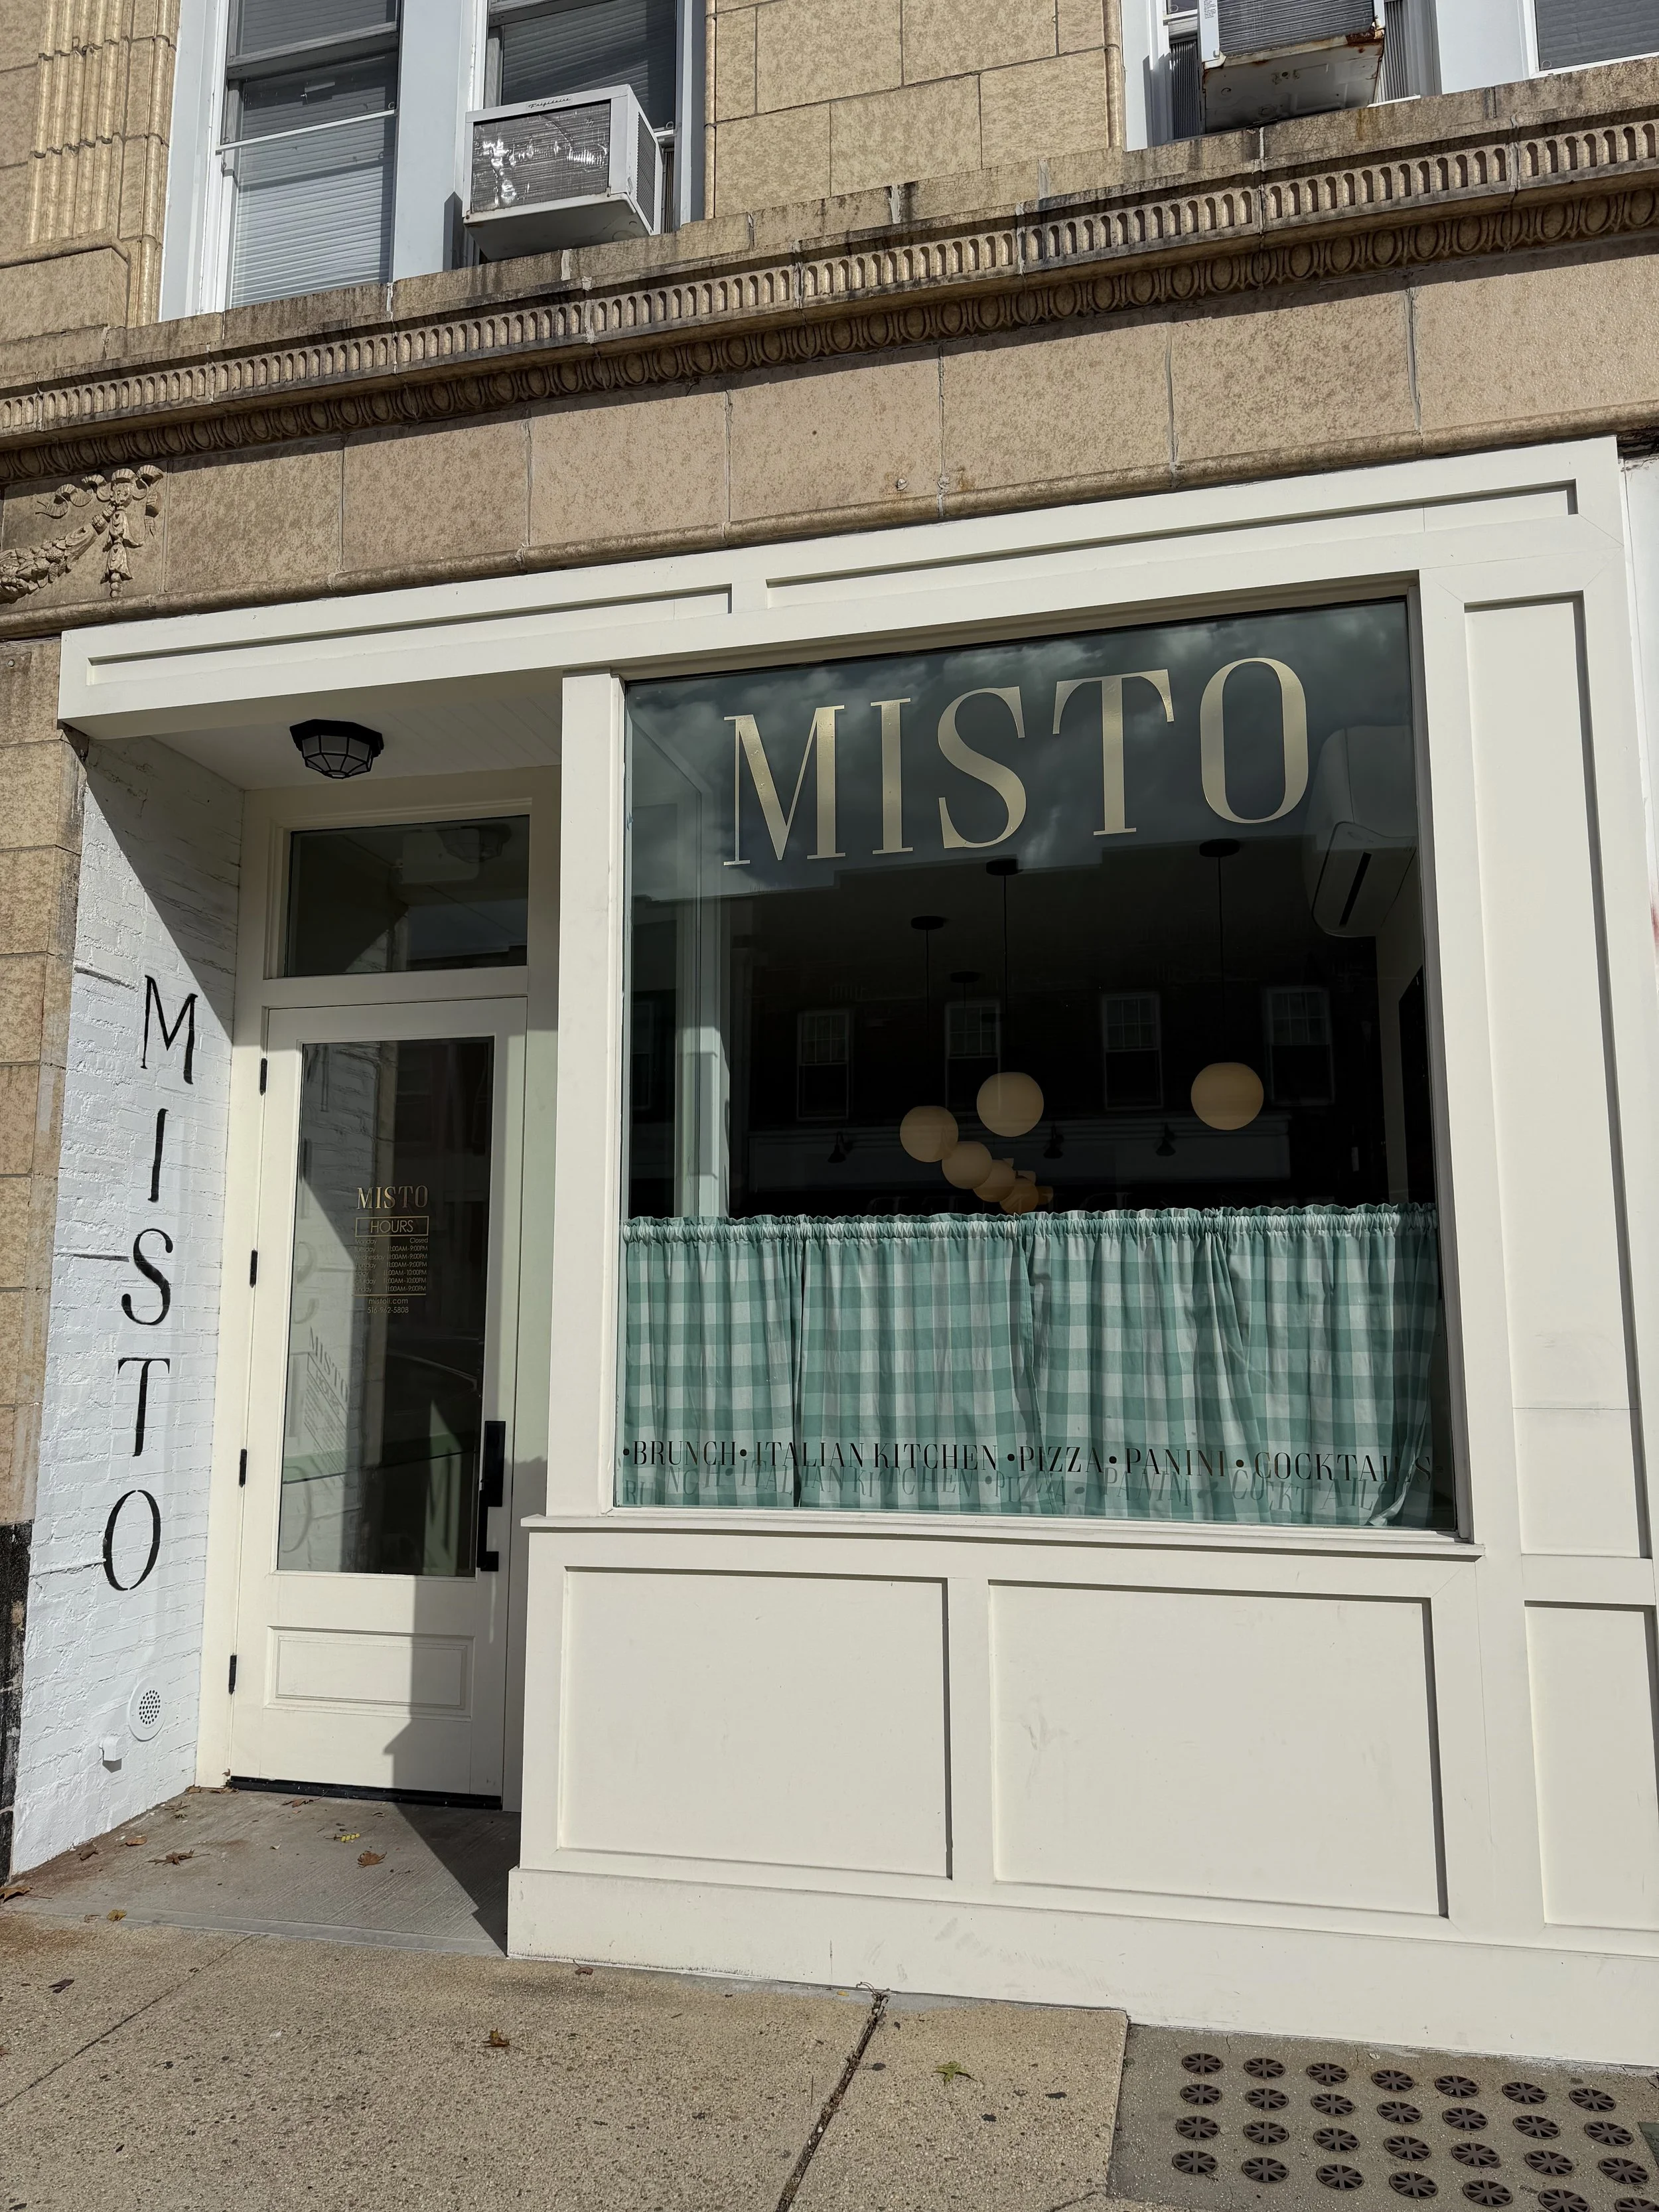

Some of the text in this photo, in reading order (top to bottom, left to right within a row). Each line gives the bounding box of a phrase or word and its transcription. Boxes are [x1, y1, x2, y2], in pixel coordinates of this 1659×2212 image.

[723, 657, 1309, 865] MISTO
[356, 1185, 429, 1209] MISTO
[370, 1220, 413, 1233] HOURS
[102, 974, 198, 1592] MISTO
[632, 1440, 736, 1466] BRUNCH
[757, 1441, 865, 1468] ITALIAN
[874, 1443, 997, 1471] KITCHEN
[1019, 1445, 1104, 1473] PIZZA
[1125, 1447, 1226, 1477] PANINI
